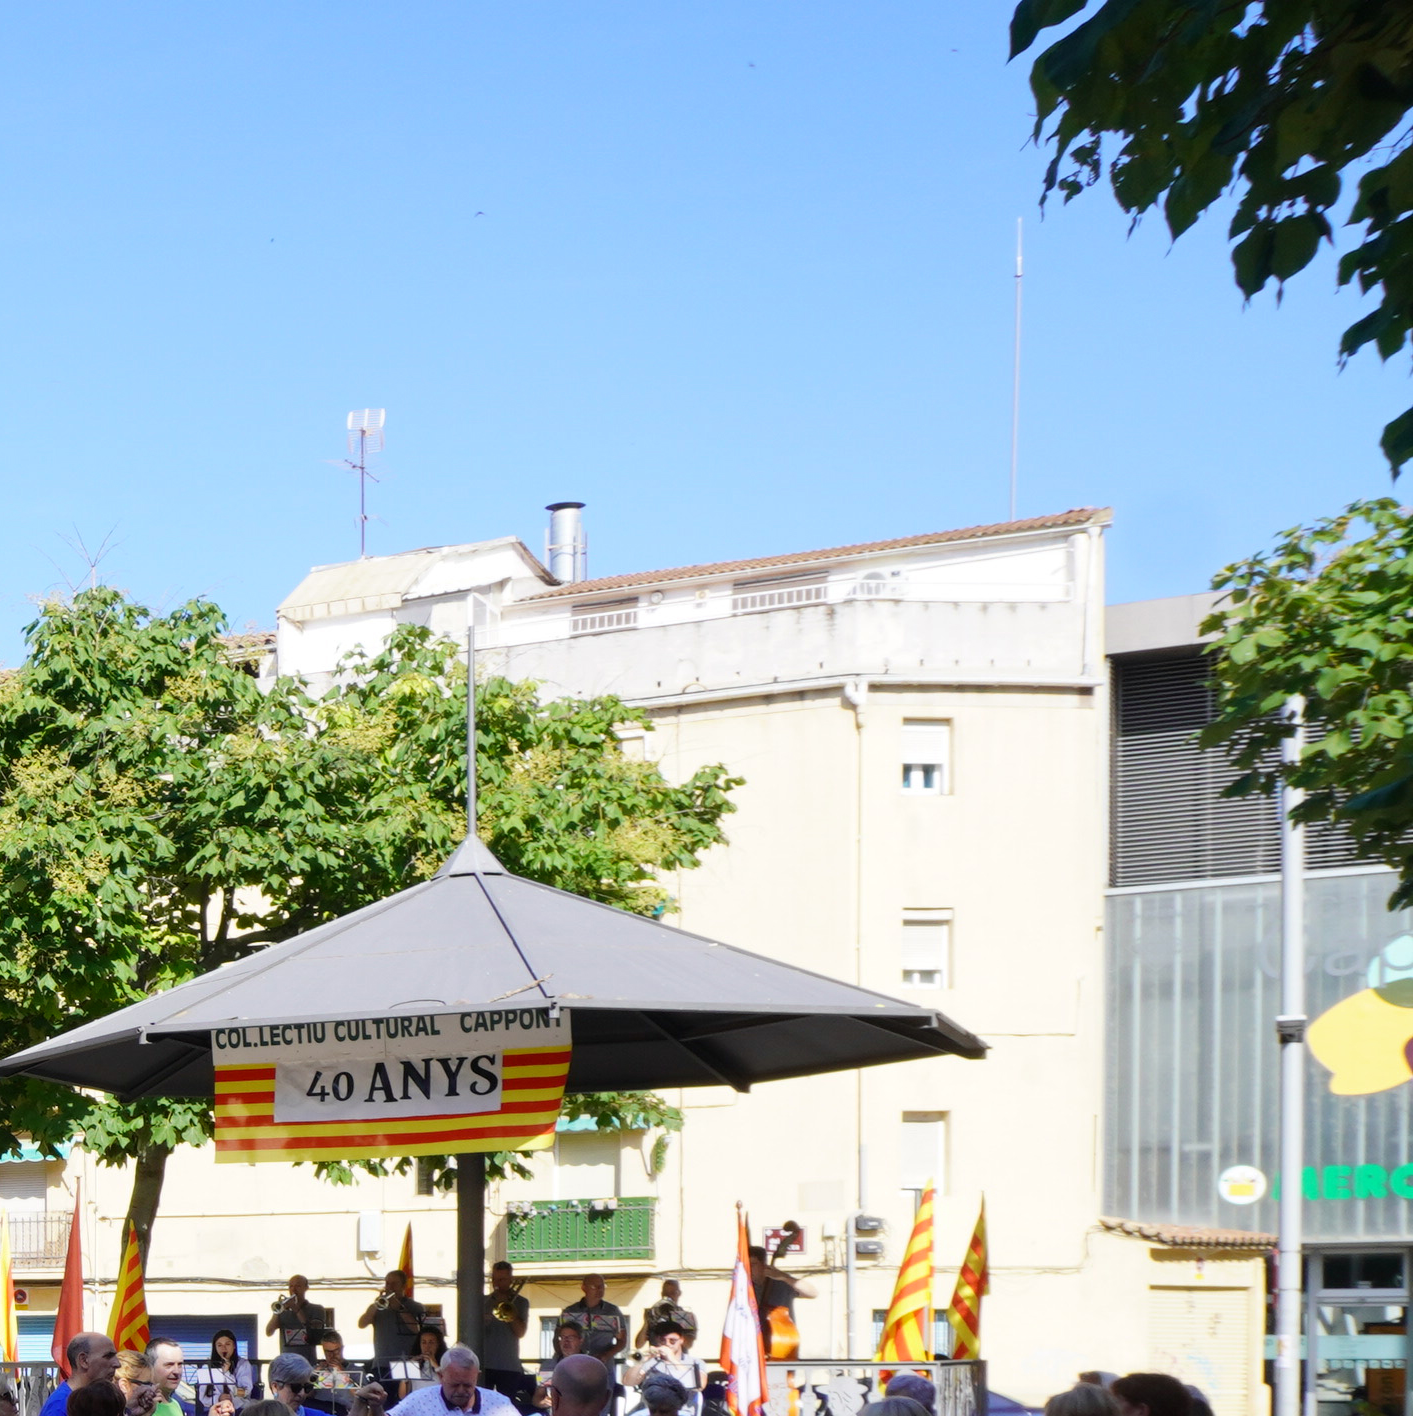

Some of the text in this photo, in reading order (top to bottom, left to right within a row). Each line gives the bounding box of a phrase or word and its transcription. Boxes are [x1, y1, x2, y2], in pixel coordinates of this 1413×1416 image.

[215, 1023, 326, 1050] COL.LECTIU
[333, 1014, 441, 1043] CULTURAL
[306, 1054, 499, 1103] 40 ANYS
